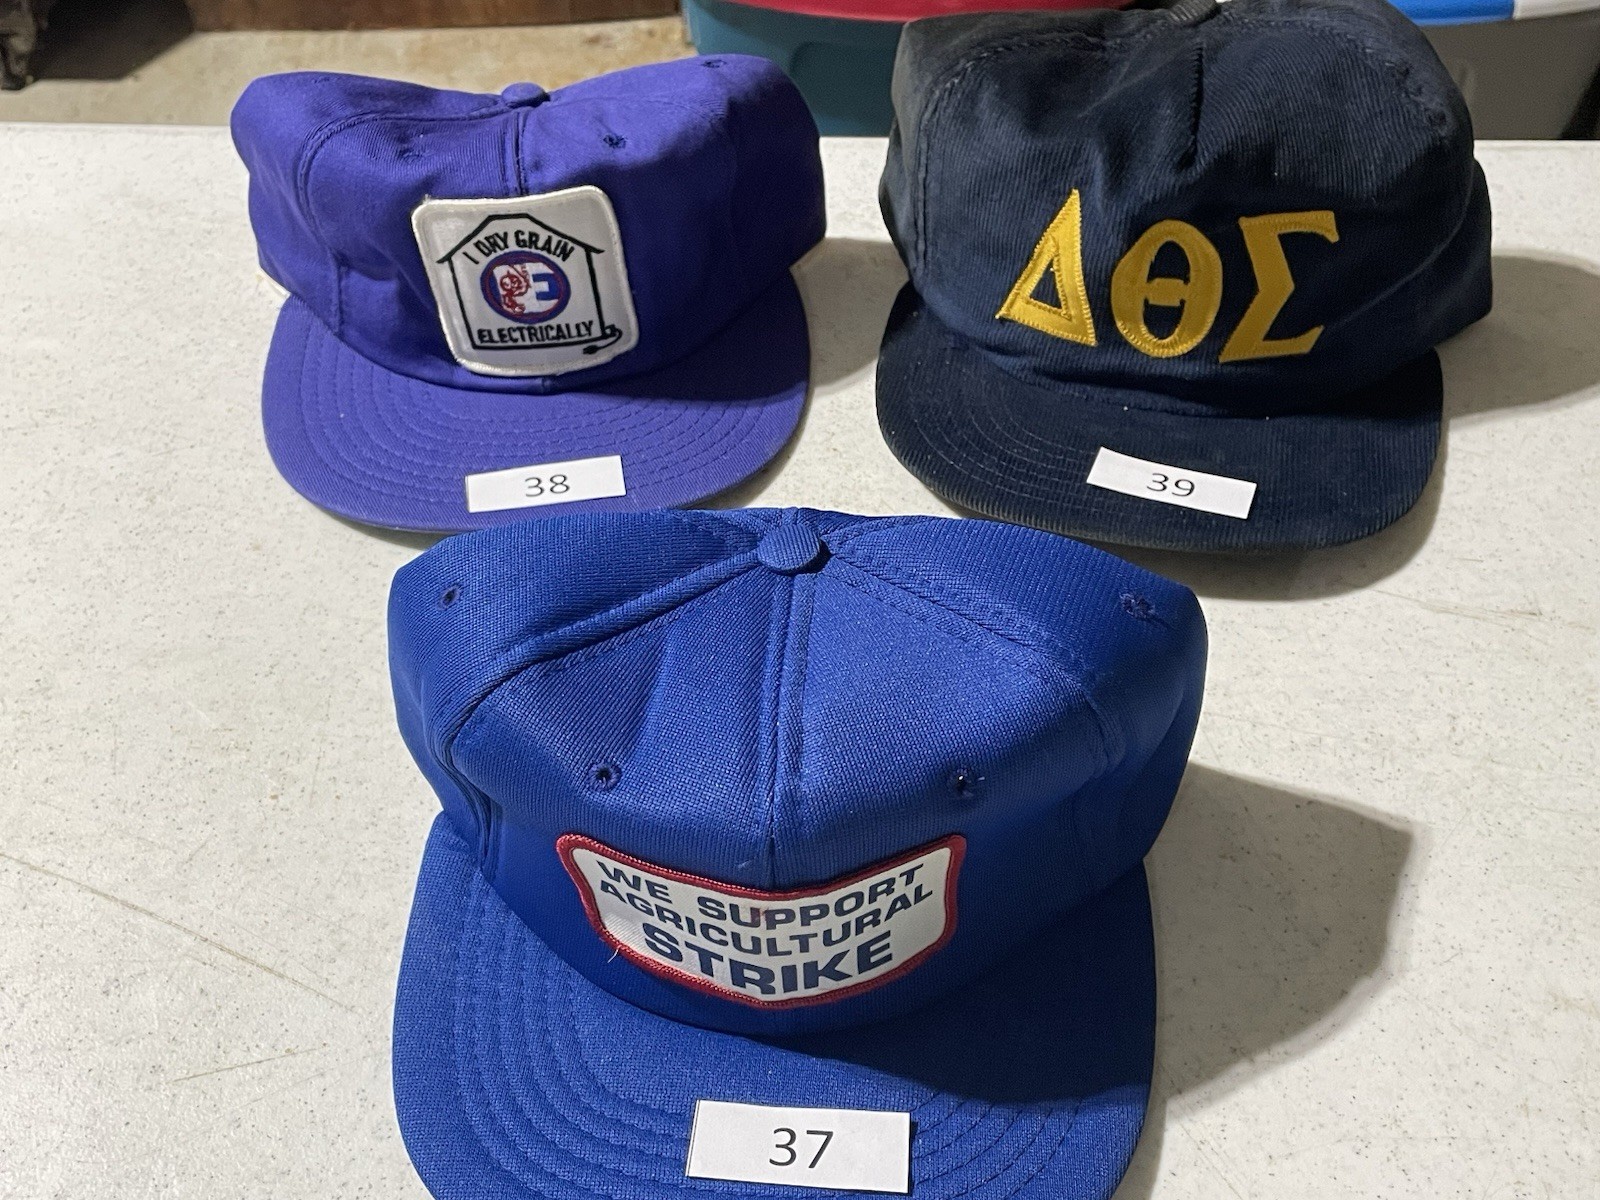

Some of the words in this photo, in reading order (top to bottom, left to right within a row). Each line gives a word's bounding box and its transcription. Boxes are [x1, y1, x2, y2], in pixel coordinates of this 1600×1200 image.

[462, 251, 480, 265] I
[473, 231, 509, 257] DRY
[514, 229, 575, 262] GRAIN
[477, 320, 594, 344] ELECTRICALLY
[524, 474, 570, 497] 38
[1146, 472, 1195, 497] 39
[596, 860, 673, 905] WE
[697, 863, 925, 931] SUPPORT
[599, 879, 933, 958] AGRICULTURAL
[642, 930, 893, 996] STRIKE
[769, 1127, 834, 1169] 37
